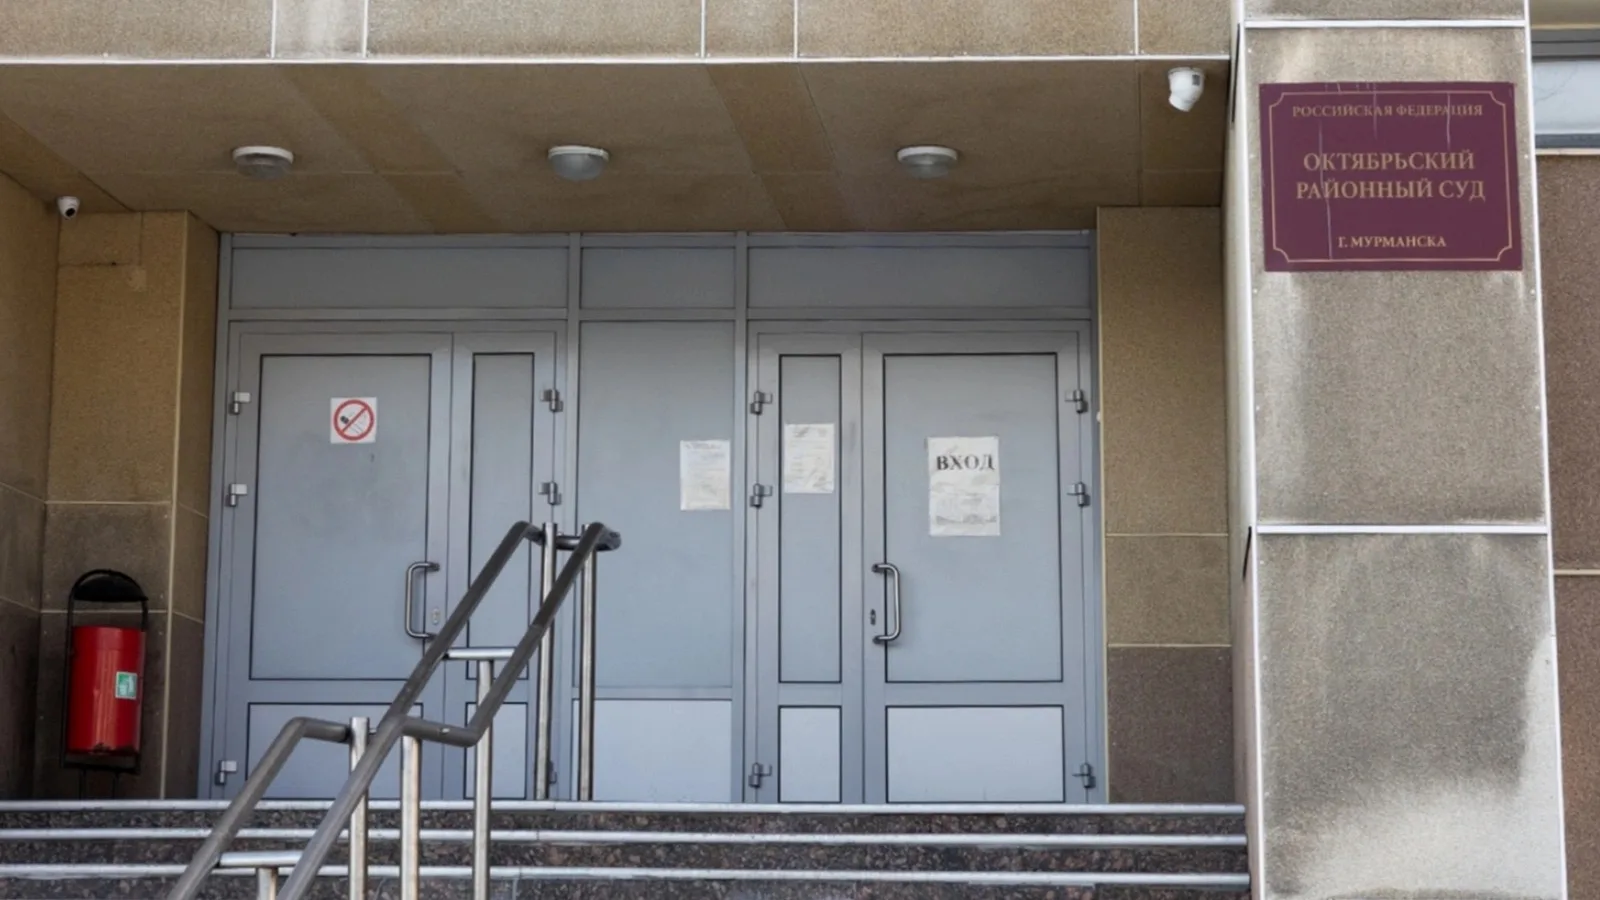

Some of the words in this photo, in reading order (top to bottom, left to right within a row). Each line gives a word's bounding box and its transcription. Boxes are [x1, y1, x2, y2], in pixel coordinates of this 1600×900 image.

[1293, 104, 1393, 117] РОССИЙСКАЯ
[1396, 104, 1483, 117] ФЕДЕРАЦИЯ
[1303, 149, 1476, 172] ОКТЯБРЬСКИЙ
[1296, 178, 1433, 200] РАЙОННЫЙ
[1439, 180, 1486, 202] СУД
[1350, 235, 1447, 248] МУРМАНСКА
[936, 454, 996, 472] ВХОД
